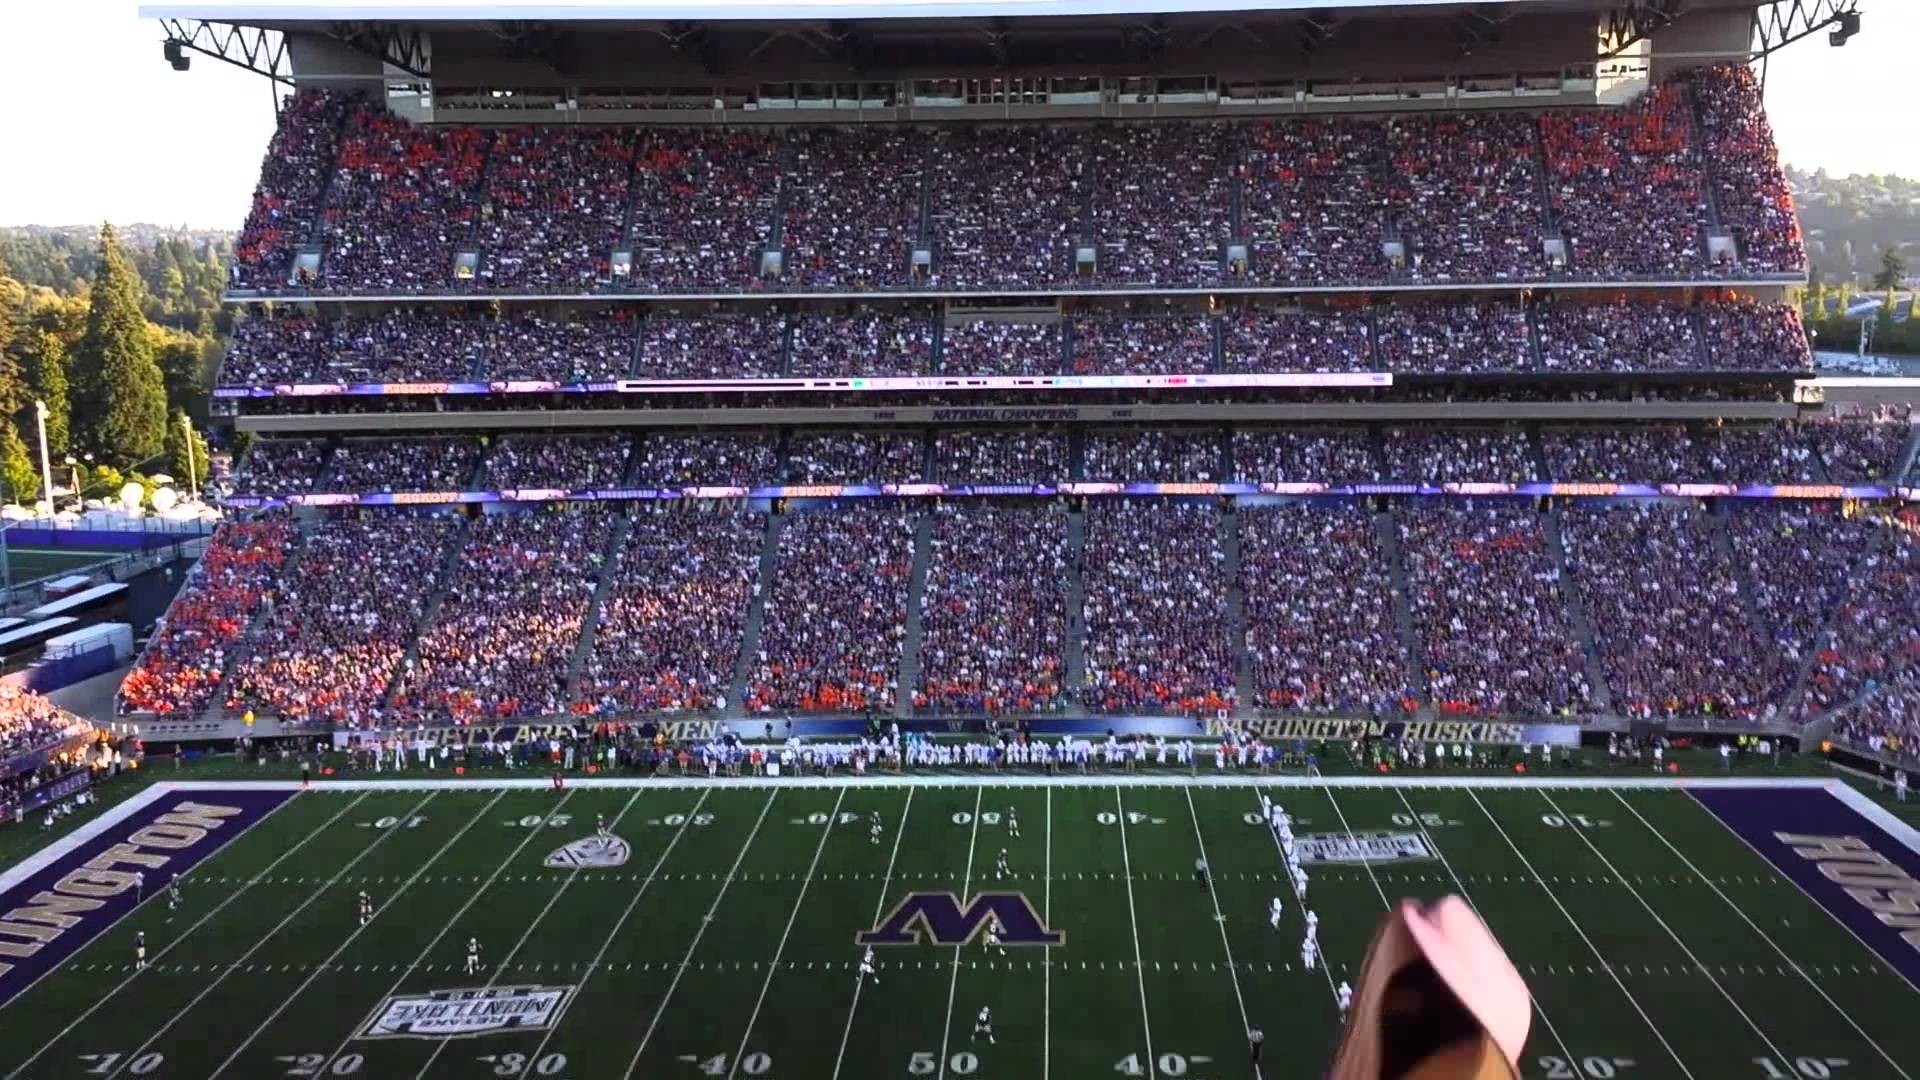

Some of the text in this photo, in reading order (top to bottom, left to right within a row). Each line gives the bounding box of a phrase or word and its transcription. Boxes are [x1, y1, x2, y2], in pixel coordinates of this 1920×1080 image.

[932, 409, 1079, 421] NATIONAL CHAMPIONS
[390, 726, 500, 745] IGHTY
[1400, 721, 1522, 743] HUSKIES
[952, 811, 1001, 825] 50
[391, 997, 554, 1021] MONTLAKE
[85, 1052, 164, 1074] 10
[288, 1053, 365, 1075] 20
[494, 1053, 567, 1075] 30
[698, 1052, 772, 1074] 40
[908, 1052, 979, 1074] 50
[1114, 1052, 1188, 1075] 40
[1539, 1055, 1616, 1079] 20
[1752, 1056, 1831, 1080] 10
